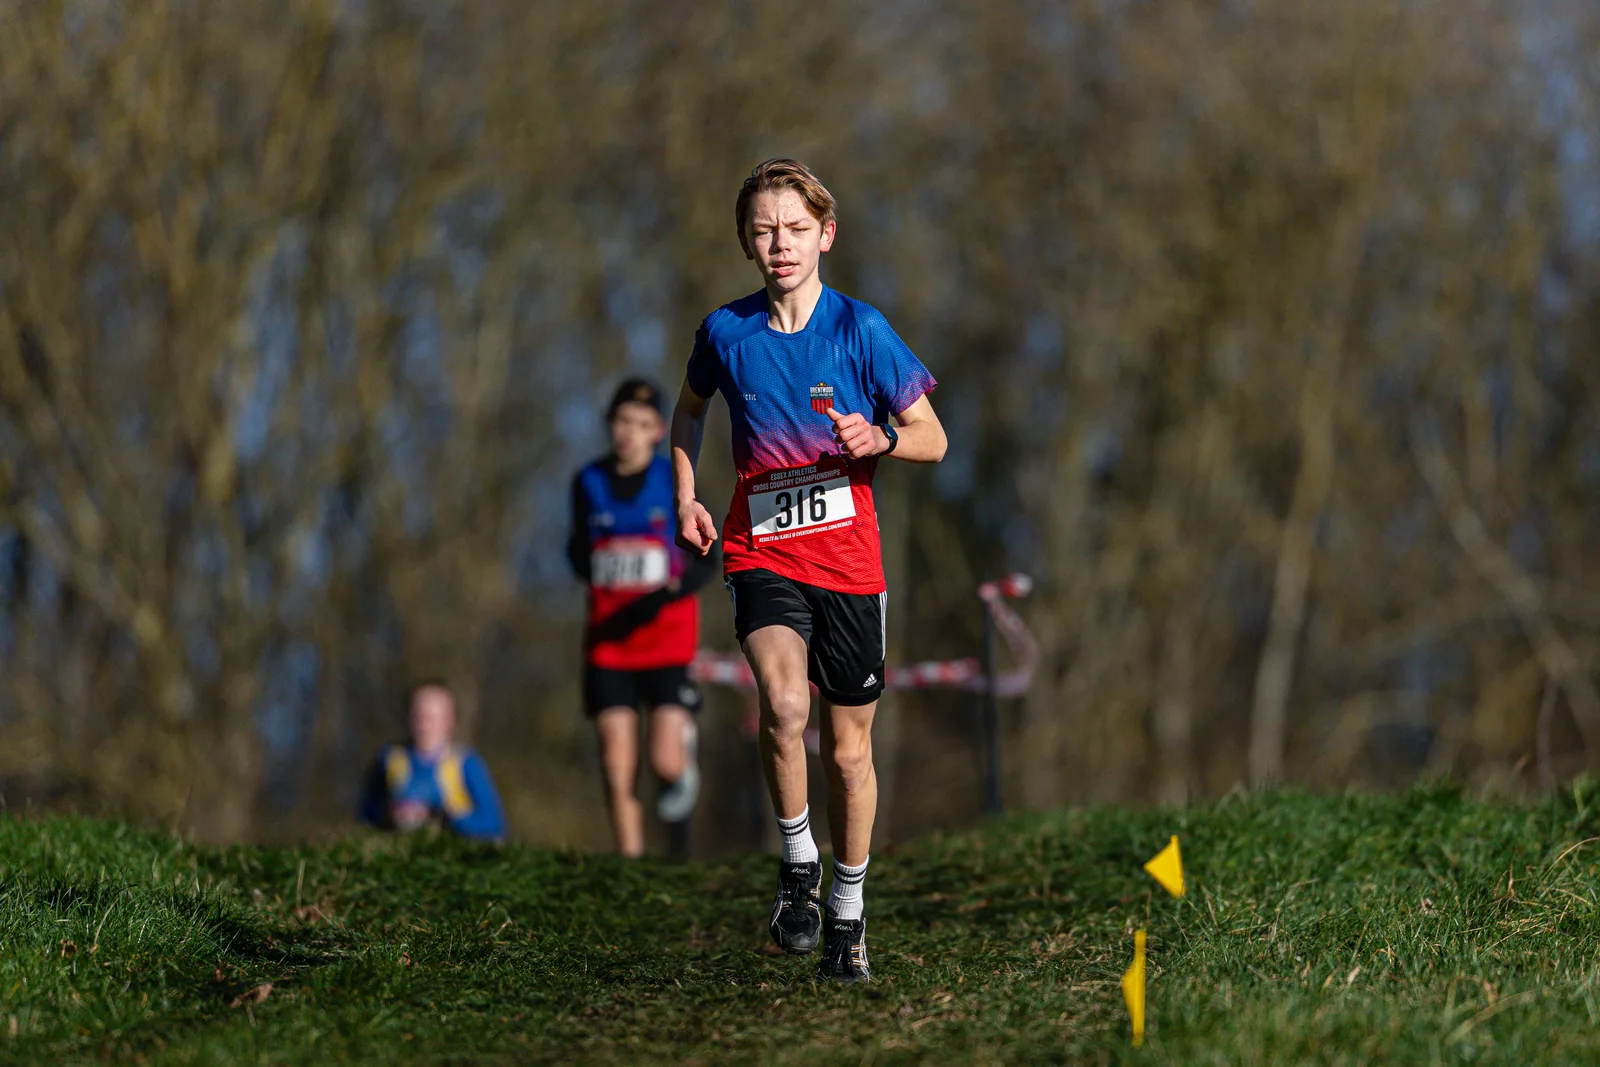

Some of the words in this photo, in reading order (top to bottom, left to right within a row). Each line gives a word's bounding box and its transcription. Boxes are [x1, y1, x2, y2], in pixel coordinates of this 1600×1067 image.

[752, 483, 769, 492] CROSS
[769, 479, 794, 489] COUNTRY
[794, 469, 841, 485] CHAMPIONSHIPS
[770, 471, 787, 481] ESSEX
[787, 466, 817, 478] ATHLETICS
[775, 484, 827, 529] 316
